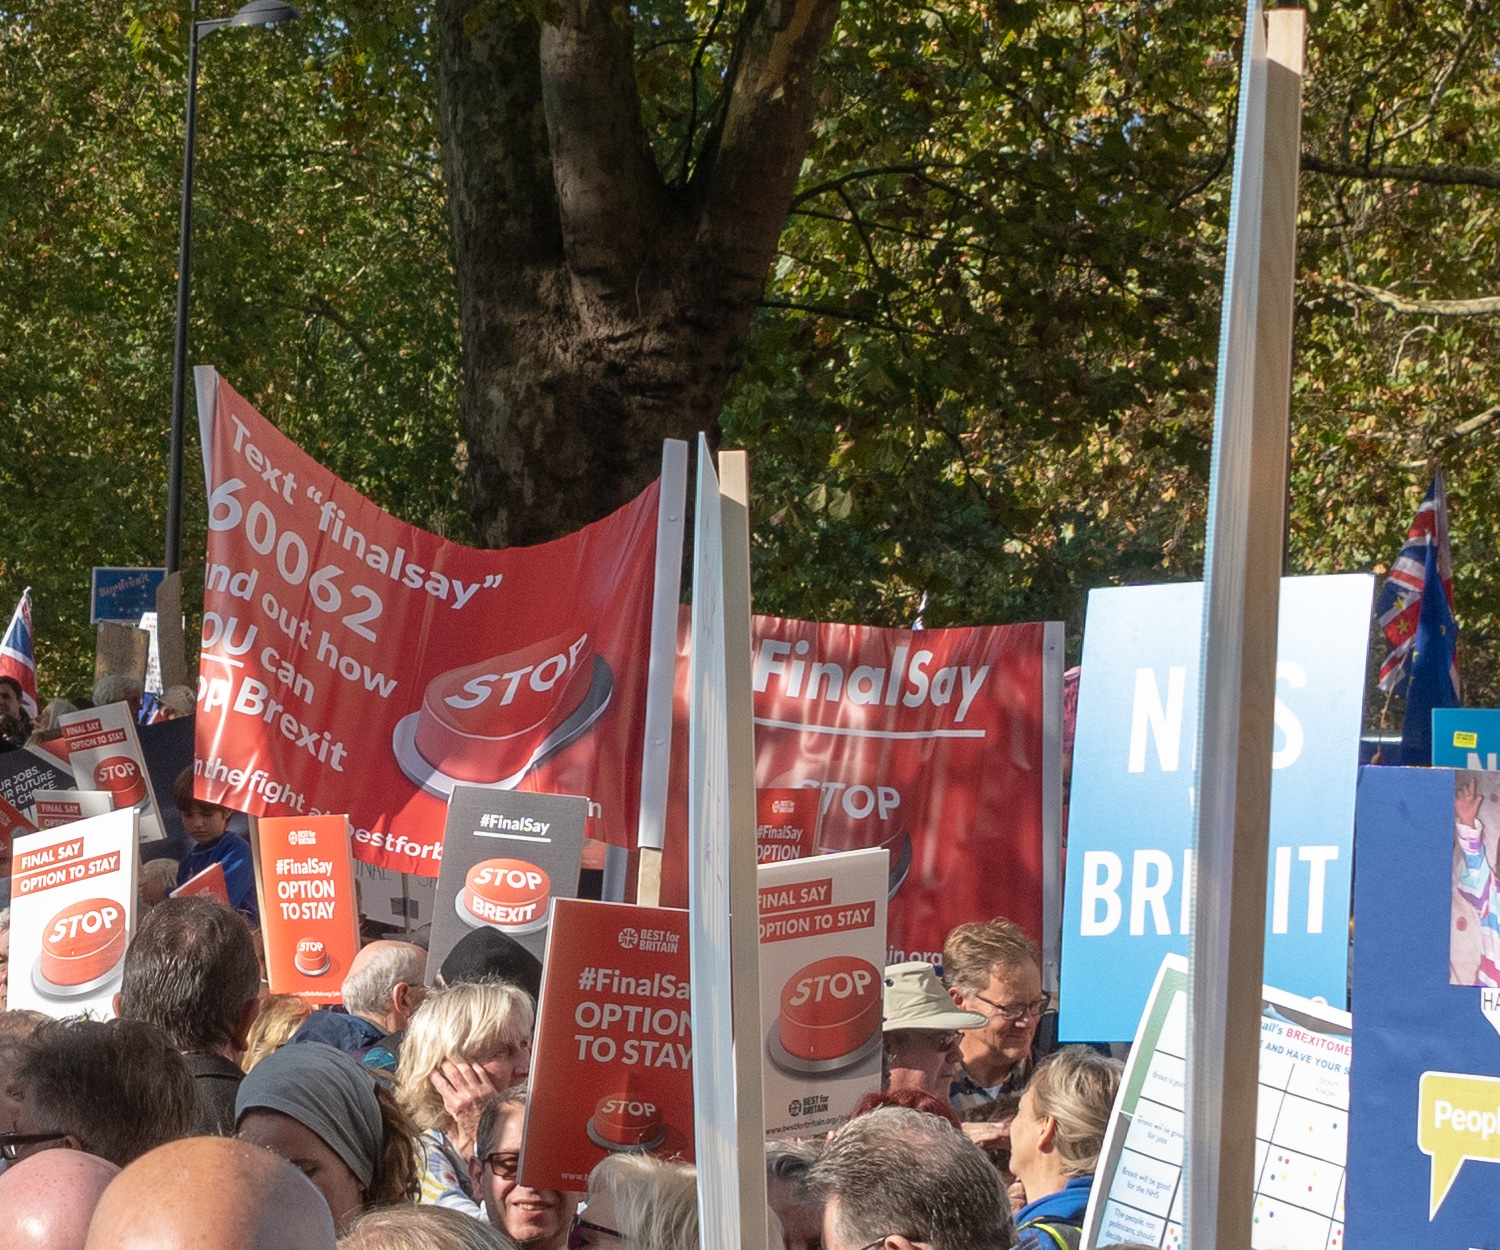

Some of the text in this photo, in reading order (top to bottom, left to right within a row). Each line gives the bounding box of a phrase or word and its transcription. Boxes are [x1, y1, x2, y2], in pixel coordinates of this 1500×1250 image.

[231, 413, 298, 505] Text
[208, 477, 384, 644] 60062
[261, 592, 398, 698] out how
[201, 611, 258, 656] OU
[261, 646, 315, 705] can
[444, 632, 588, 710] STOP
[752, 638, 989, 723] FinalSay
[66, 722, 100, 735] FINAL SAY
[197, 675, 348, 772] op Brexit
[1128, 660, 1308, 774] NS
[70, 732, 124, 750] OPTION TO STAY
[12, 766, 41, 787] JOBS.
[97, 762, 136, 782] STOP
[15, 770, 57, 798] FUTURE.
[204, 758, 306, 814] the fight
[41, 803, 79, 814] FINAL SAY
[479, 813, 551, 836] #FinalSay
[757, 824, 804, 843] #FinalSay
[21, 842, 81, 870] FINAL SAY
[757, 844, 801, 861] OPTION
[20, 856, 117, 893] OPTION TO STAY
[275, 858, 333, 876] #FinalSay
[473, 867, 542, 890] STOP
[277, 879, 335, 899] OPTION
[800, 884, 828, 904] SAY
[1079, 845, 1339, 938] BRIT
[280, 901, 335, 920] TO STAY
[472, 895, 536, 922] BREXIT
[813, 914, 834, 930] TO
[837, 907, 871, 927] STAY
[48, 907, 118, 943] STOP
[640, 928, 680, 943] BEST for
[298, 941, 324, 952] STOP
[639, 940, 679, 954] BRITAIN
[578, 966, 691, 1001] #FinalSa
[789, 969, 872, 1006] STOP
[574, 1034, 692, 1070] TO STAY
[1265, 1042, 1342, 1074] AND HAVE YOUR
[600, 1099, 656, 1117] STOP
[802, 1095, 830, 1106] BEST for
[802, 1103, 829, 1117] BRITAIN
[1122, 1167, 1171, 1193] Brexit will good
[1127, 1181, 1160, 1200] for the NHS
[1114, 1208, 1125, 1220] The
